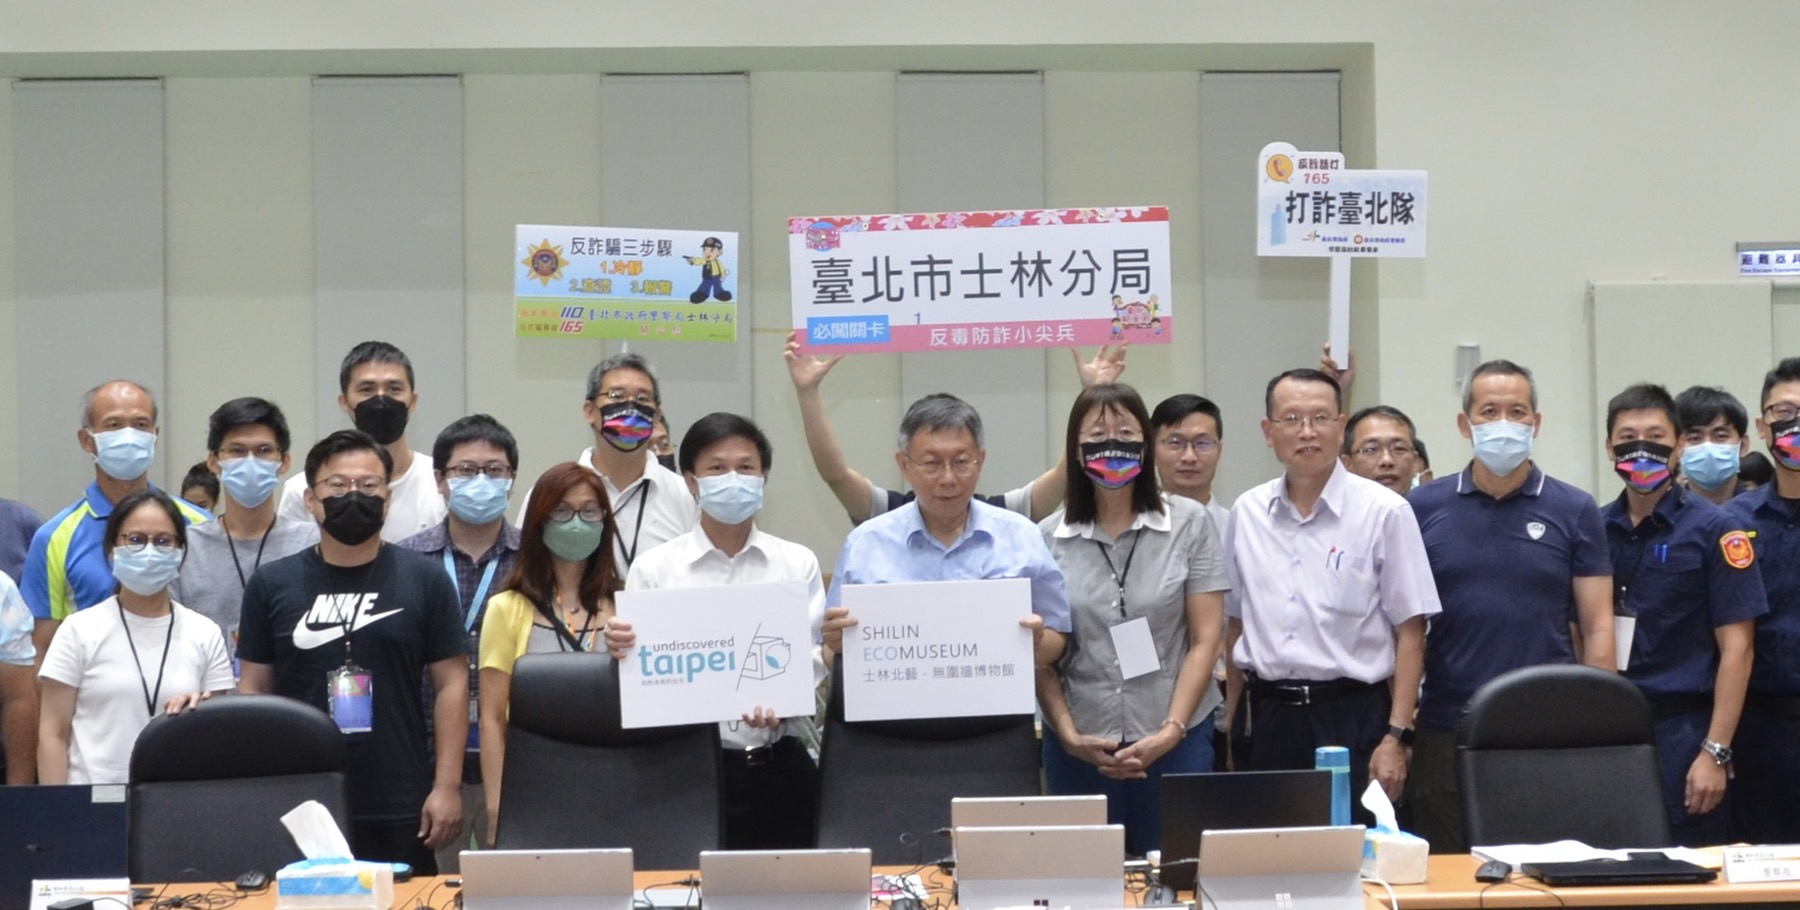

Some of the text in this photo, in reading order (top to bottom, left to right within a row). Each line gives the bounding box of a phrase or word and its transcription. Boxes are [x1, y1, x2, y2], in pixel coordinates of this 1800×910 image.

[1286, 191, 1414, 225] 打詐臺北隊
[570, 237, 673, 258] 反詐騙三步驟
[811, 248, 1152, 305] 臺北市士林分局
[560, 306, 584, 319] 110
[559, 320, 584, 333] 165
[813, 321, 885, 340] 必闖關卡
[930, 323, 1076, 347] 反毒防詐小尖兵
[306, 592, 379, 624] NIKE
[863, 624, 920, 641] SHILIN
[653, 636, 735, 652] undiscovered
[864, 643, 978, 662] ECOMUSEUM
[638, 645, 736, 683] taipei
[863, 667, 918, 683] 士林北藝
[932, 663, 1015, 680] 無圍牆博物館
